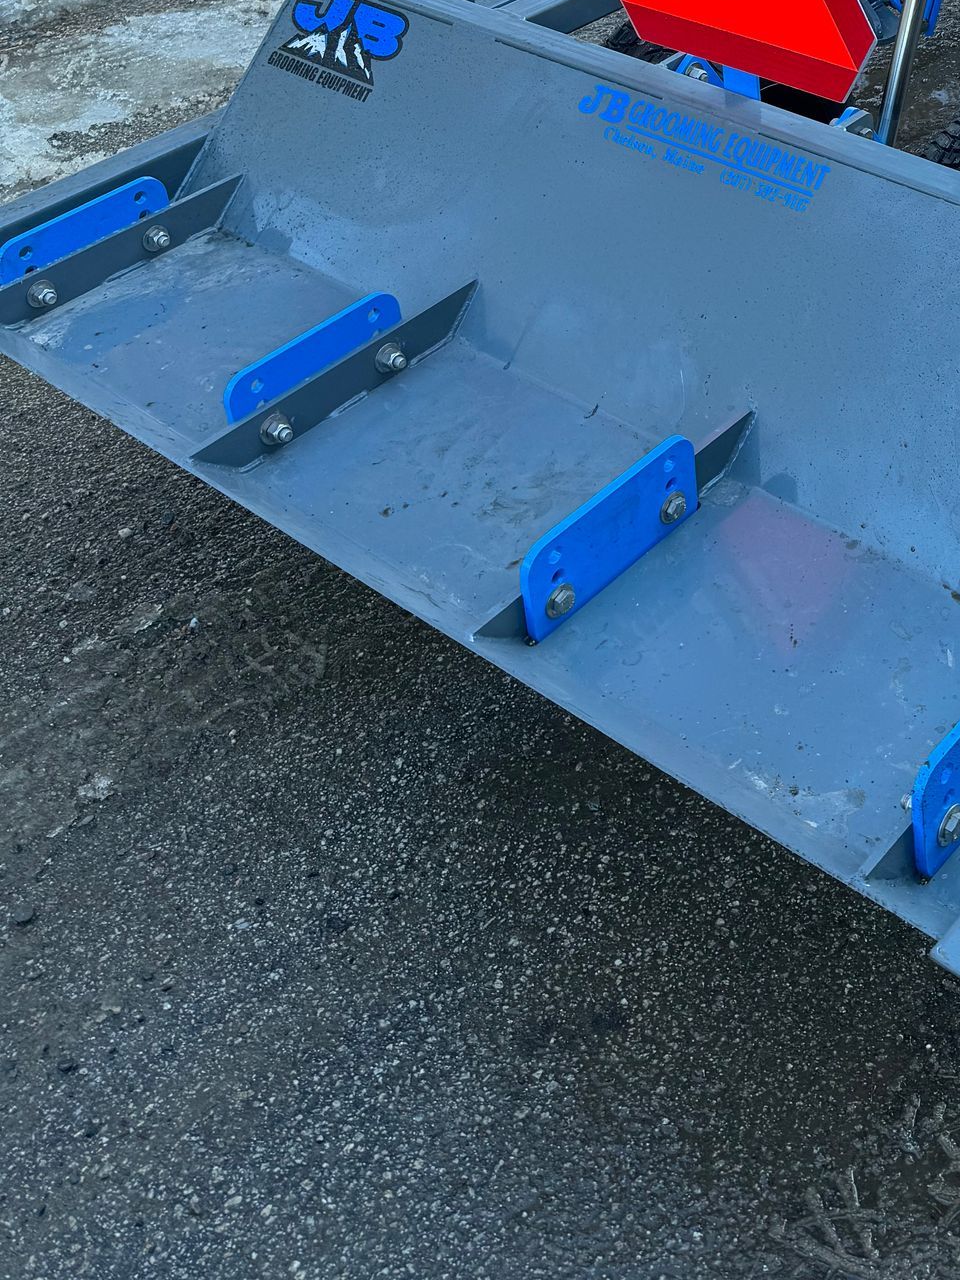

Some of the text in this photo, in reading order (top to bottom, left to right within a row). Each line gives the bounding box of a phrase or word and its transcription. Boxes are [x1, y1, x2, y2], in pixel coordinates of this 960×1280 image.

[267, 50, 373, 103] GROOMING EQUIPMENT
[578, 84, 831, 190] JB GROOMING EQUIPMENT
